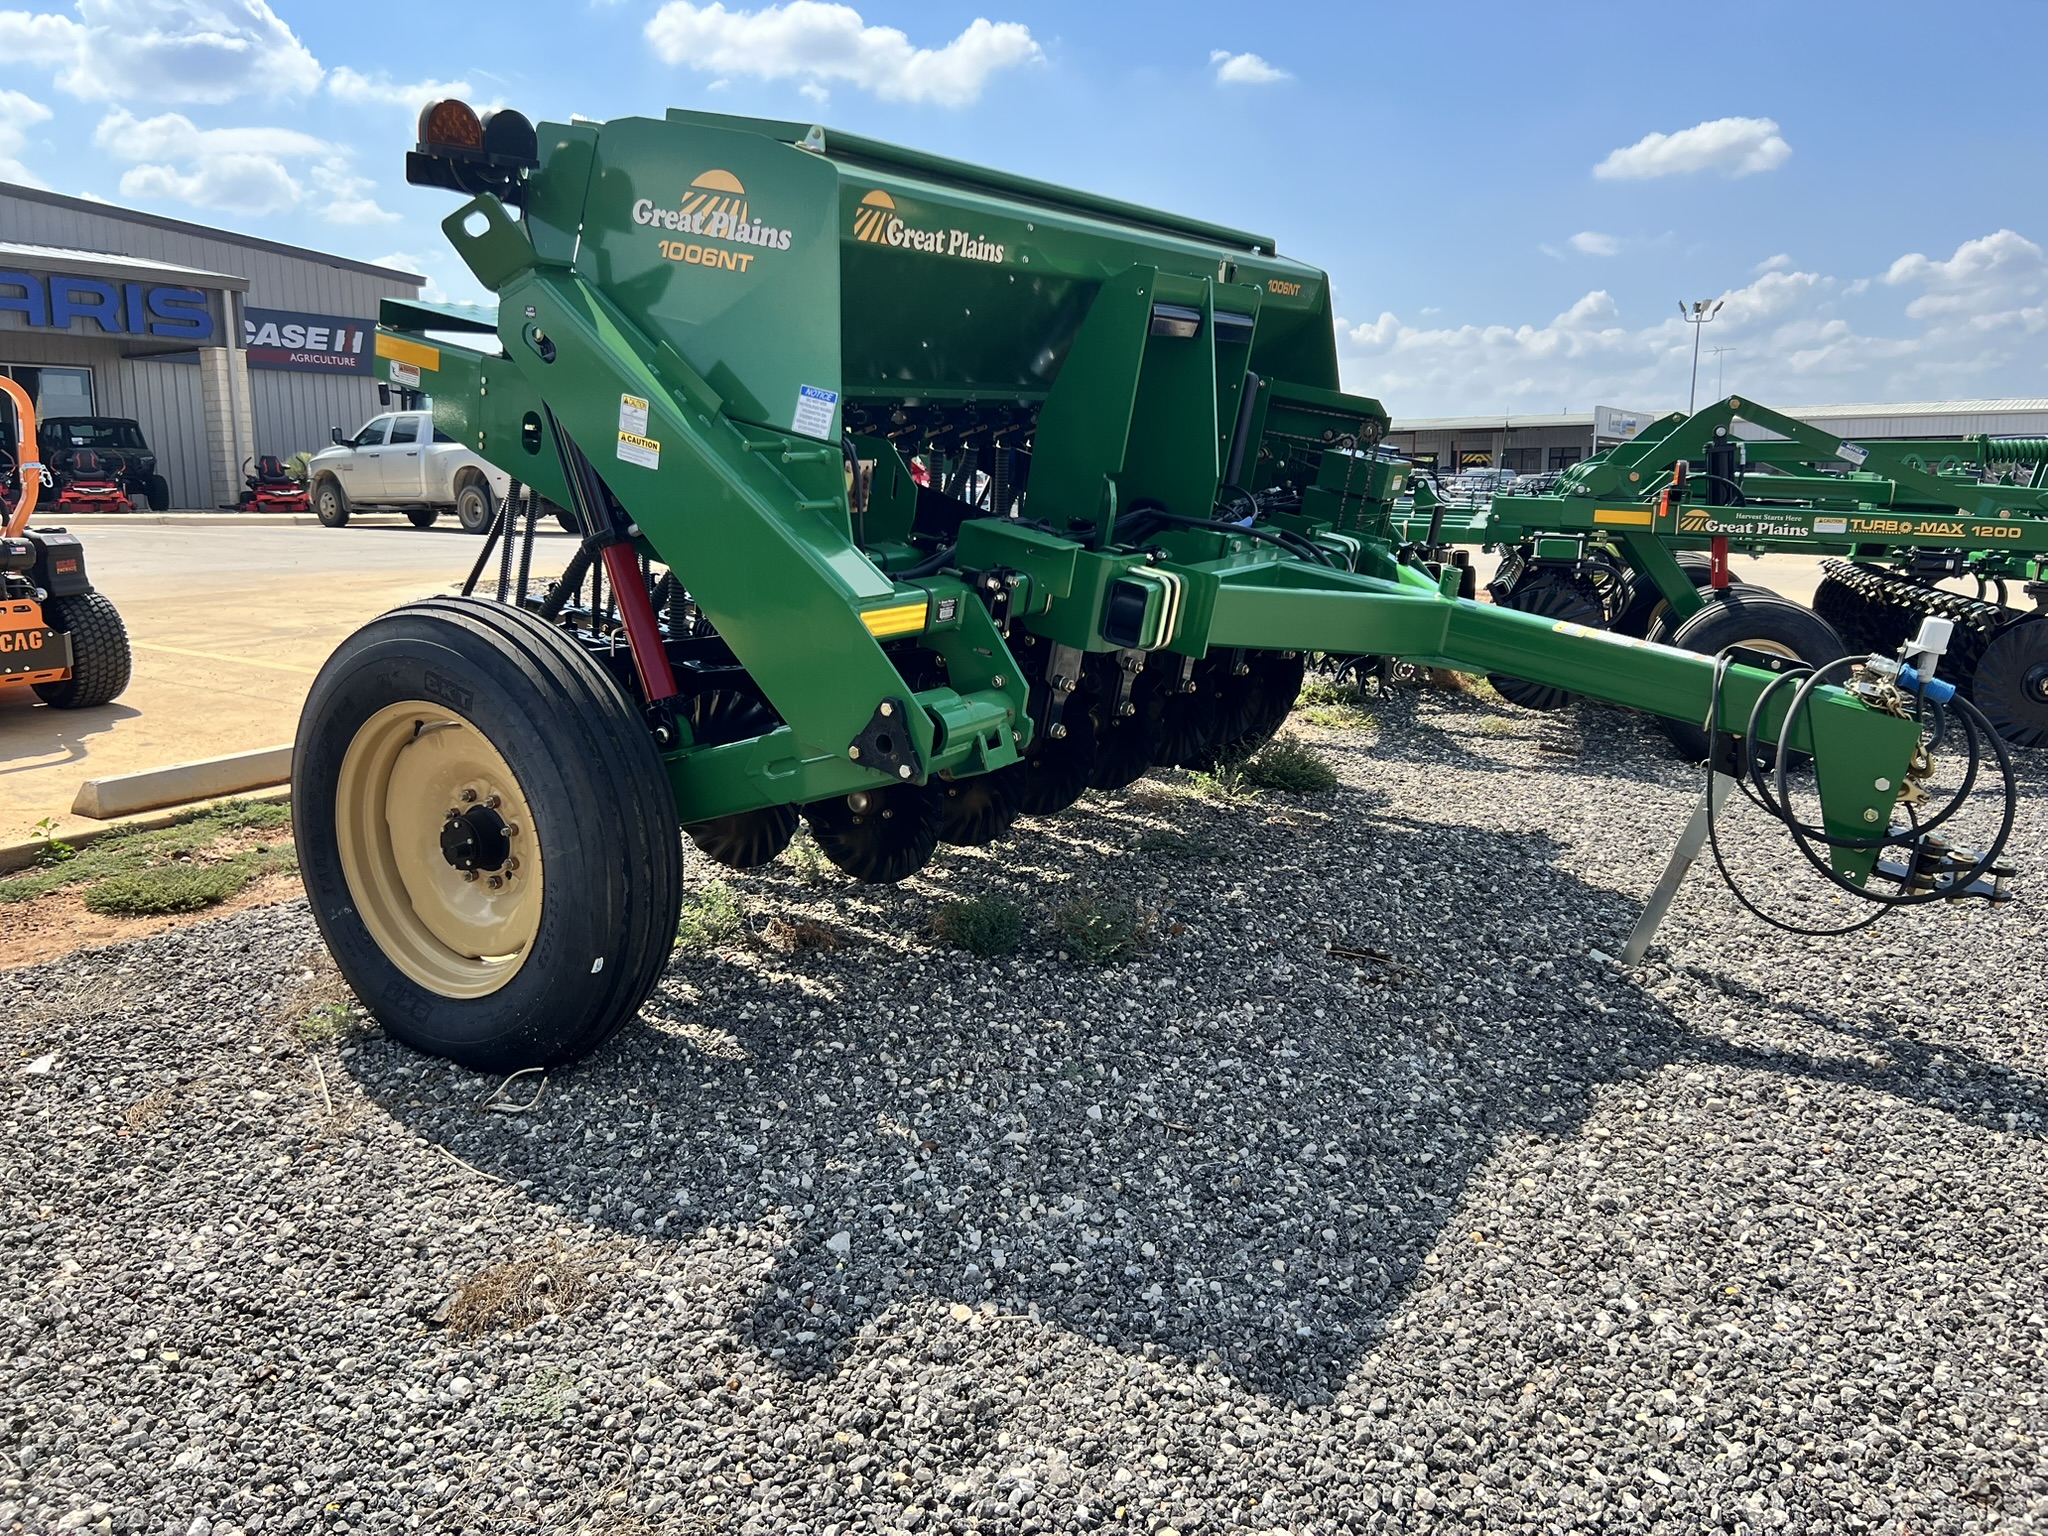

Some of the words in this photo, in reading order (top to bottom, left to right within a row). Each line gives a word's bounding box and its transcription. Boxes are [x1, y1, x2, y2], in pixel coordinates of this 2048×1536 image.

[632, 199, 705, 235] Great
[711, 211, 792, 251] Plains
[887, 217, 946, 254] Great
[948, 229, 1004, 263] Plains
[658, 240, 754, 273] 1006NT
[1268, 280, 1300, 296] 1006NT
[290, 353, 356, 366] AGRICULTURE
[805, 388, 833, 401] NOTICE
[627, 435, 658, 450] CAUTION
[1736, 512, 1762, 520] Harvest
[1763, 513, 1784, 521] Starts
[1785, 514, 1802, 522] Here
[1705, 520, 1753, 534] Great
[1756, 522, 1809, 537] Plains
[1971, 525, 2022, 539] 1200
[0, 631, 43, 653] CAG
